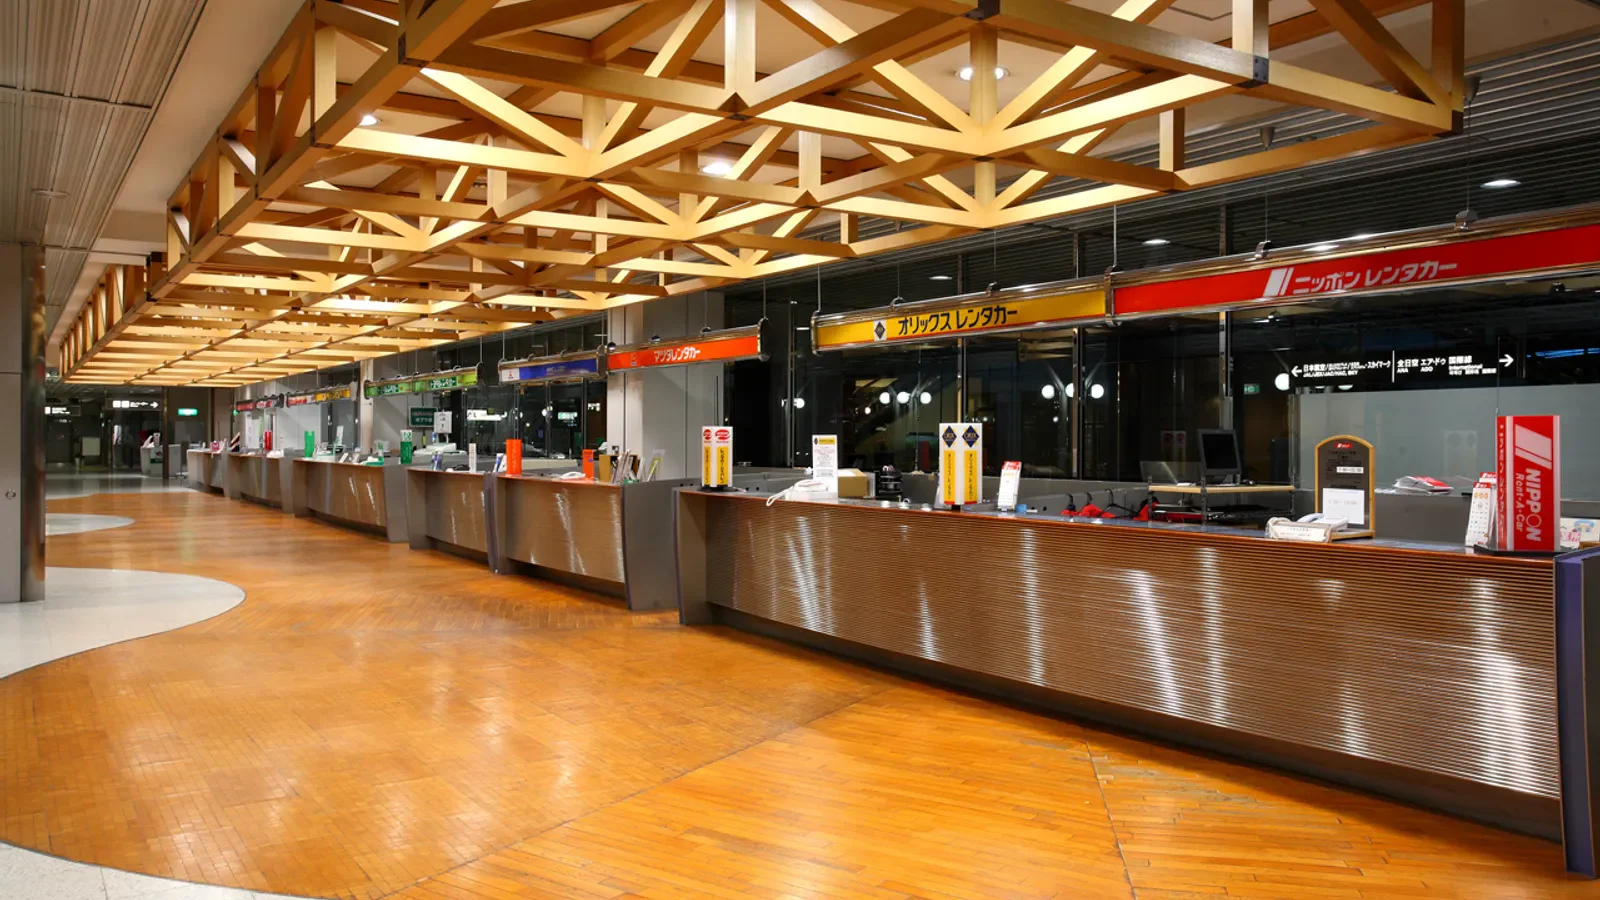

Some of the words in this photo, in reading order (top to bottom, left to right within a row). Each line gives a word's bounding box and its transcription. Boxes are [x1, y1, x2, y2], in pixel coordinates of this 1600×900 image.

[1293, 272, 1361, 295] ニッポン
[1364, 260, 1458, 287] レンタカー
[898, 312, 952, 336] オリックス
[956, 305, 1018, 328] レンタカー
[1525, 468, 1542, 541] NIPPON
